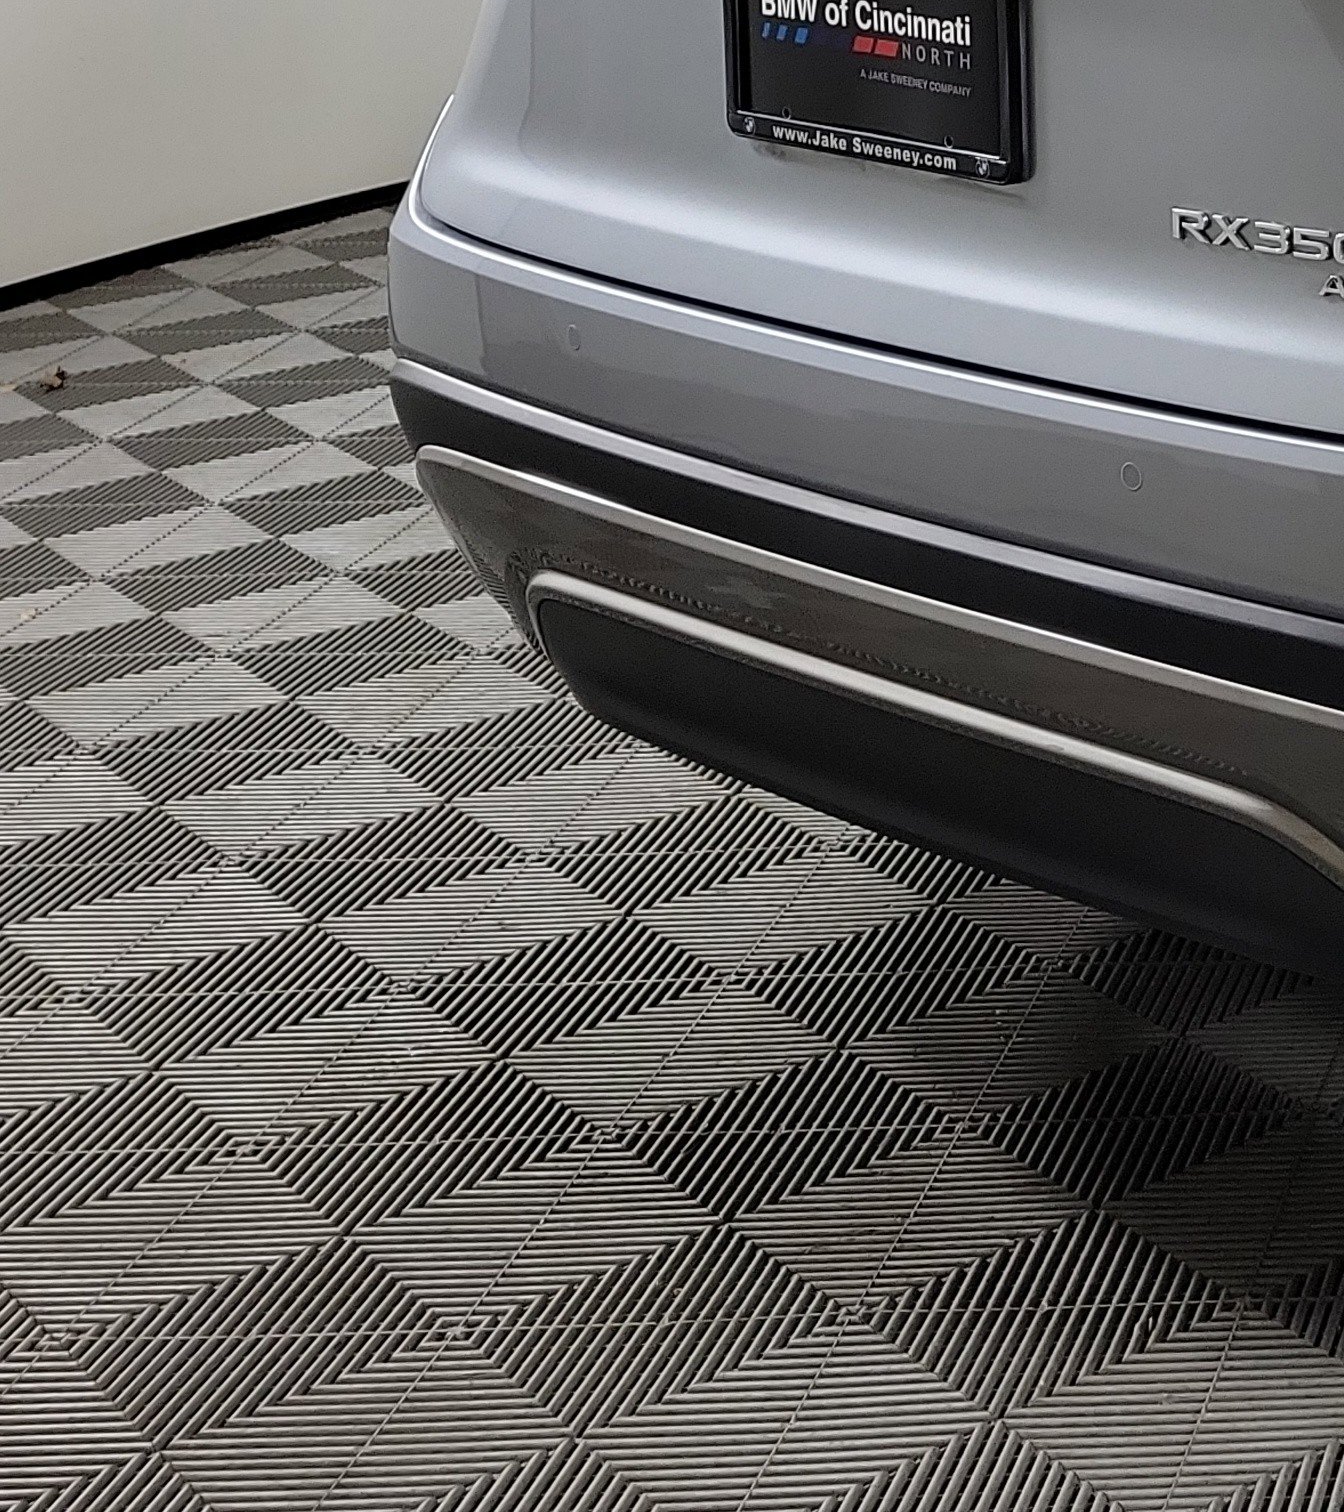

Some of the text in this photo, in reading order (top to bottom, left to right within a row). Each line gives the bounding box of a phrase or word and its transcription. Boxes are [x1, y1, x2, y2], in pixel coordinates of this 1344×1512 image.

[854, 0, 972, 46] Cincinnati
[902, 41, 971, 71] NORTH
[868, 69, 890, 84] JAKE
[890, 73, 929, 90] SWEENEY
[929, 80, 971, 98] COMPANY
[771, 123, 957, 172] www.Jake Sweeney.com
